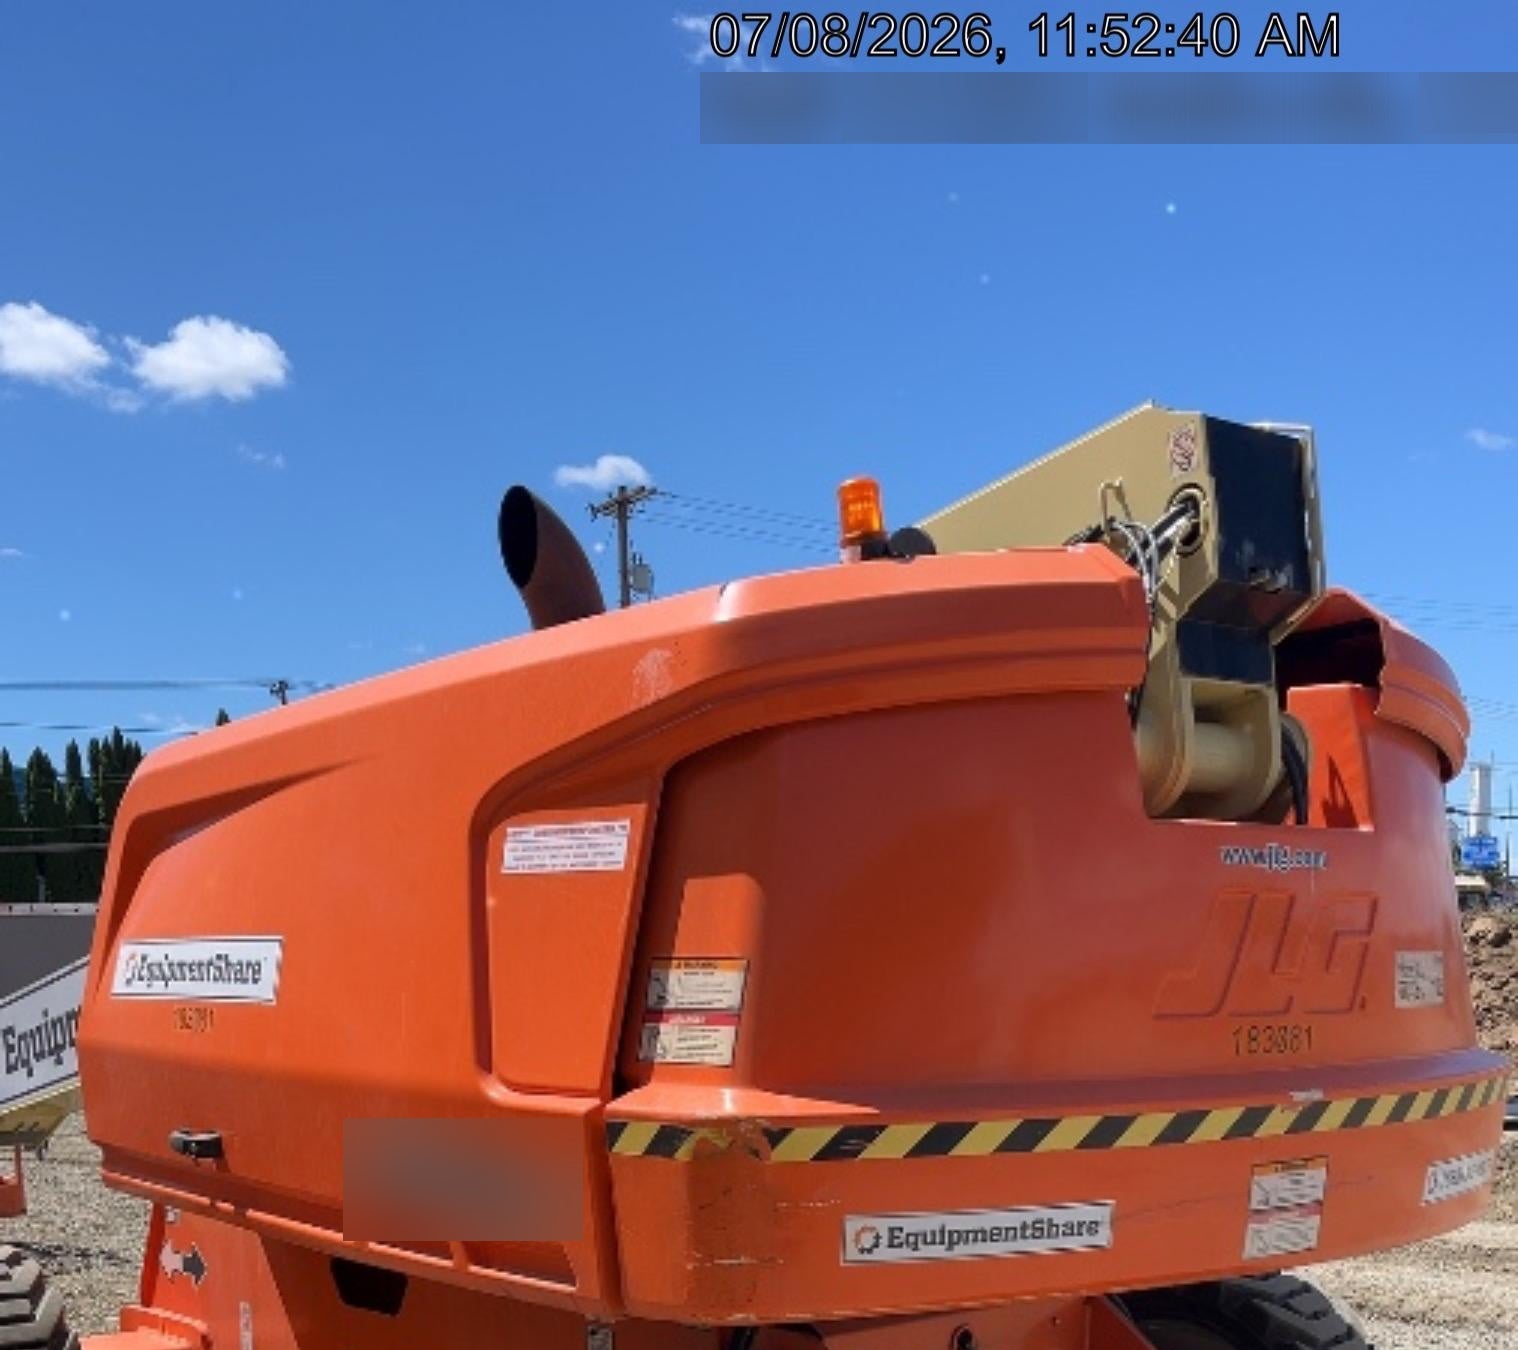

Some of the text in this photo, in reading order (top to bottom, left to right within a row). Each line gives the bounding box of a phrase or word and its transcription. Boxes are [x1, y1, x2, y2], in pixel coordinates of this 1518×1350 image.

[1151, 885, 1379, 1018] JLG
[137, 953, 262, 989] EquipmentShare
[886, 1217, 1100, 1252] EquipmentShare
